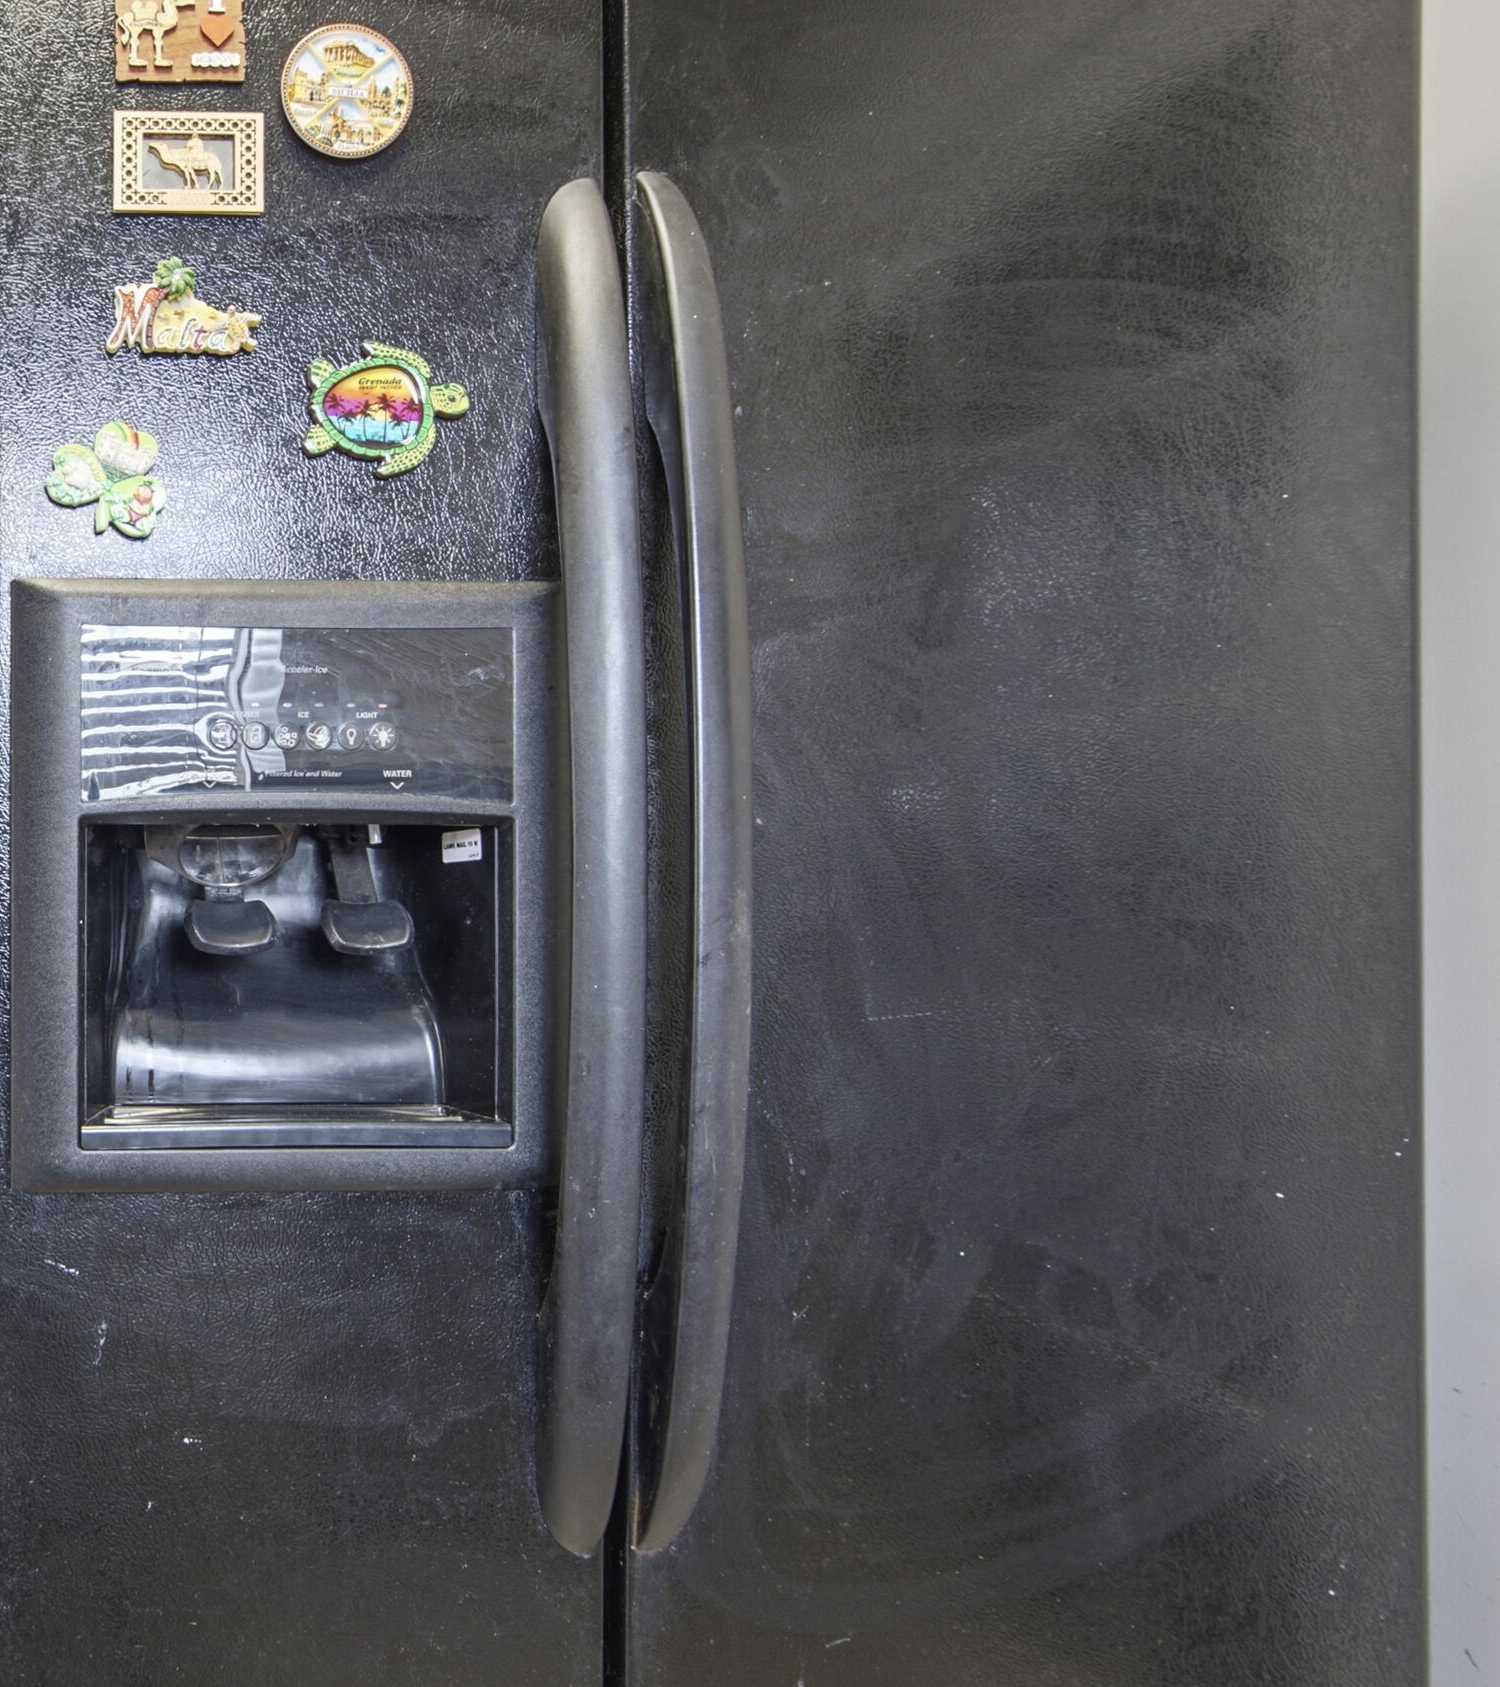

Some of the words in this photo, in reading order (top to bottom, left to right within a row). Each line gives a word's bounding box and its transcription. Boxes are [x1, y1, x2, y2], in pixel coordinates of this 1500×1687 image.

[107, 286, 230, 352] Malta
[358, 377, 403, 385] Grenada
[297, 711, 309, 719] ICE
[356, 711, 379, 719] LIGHT
[382, 769, 412, 778] WATER
